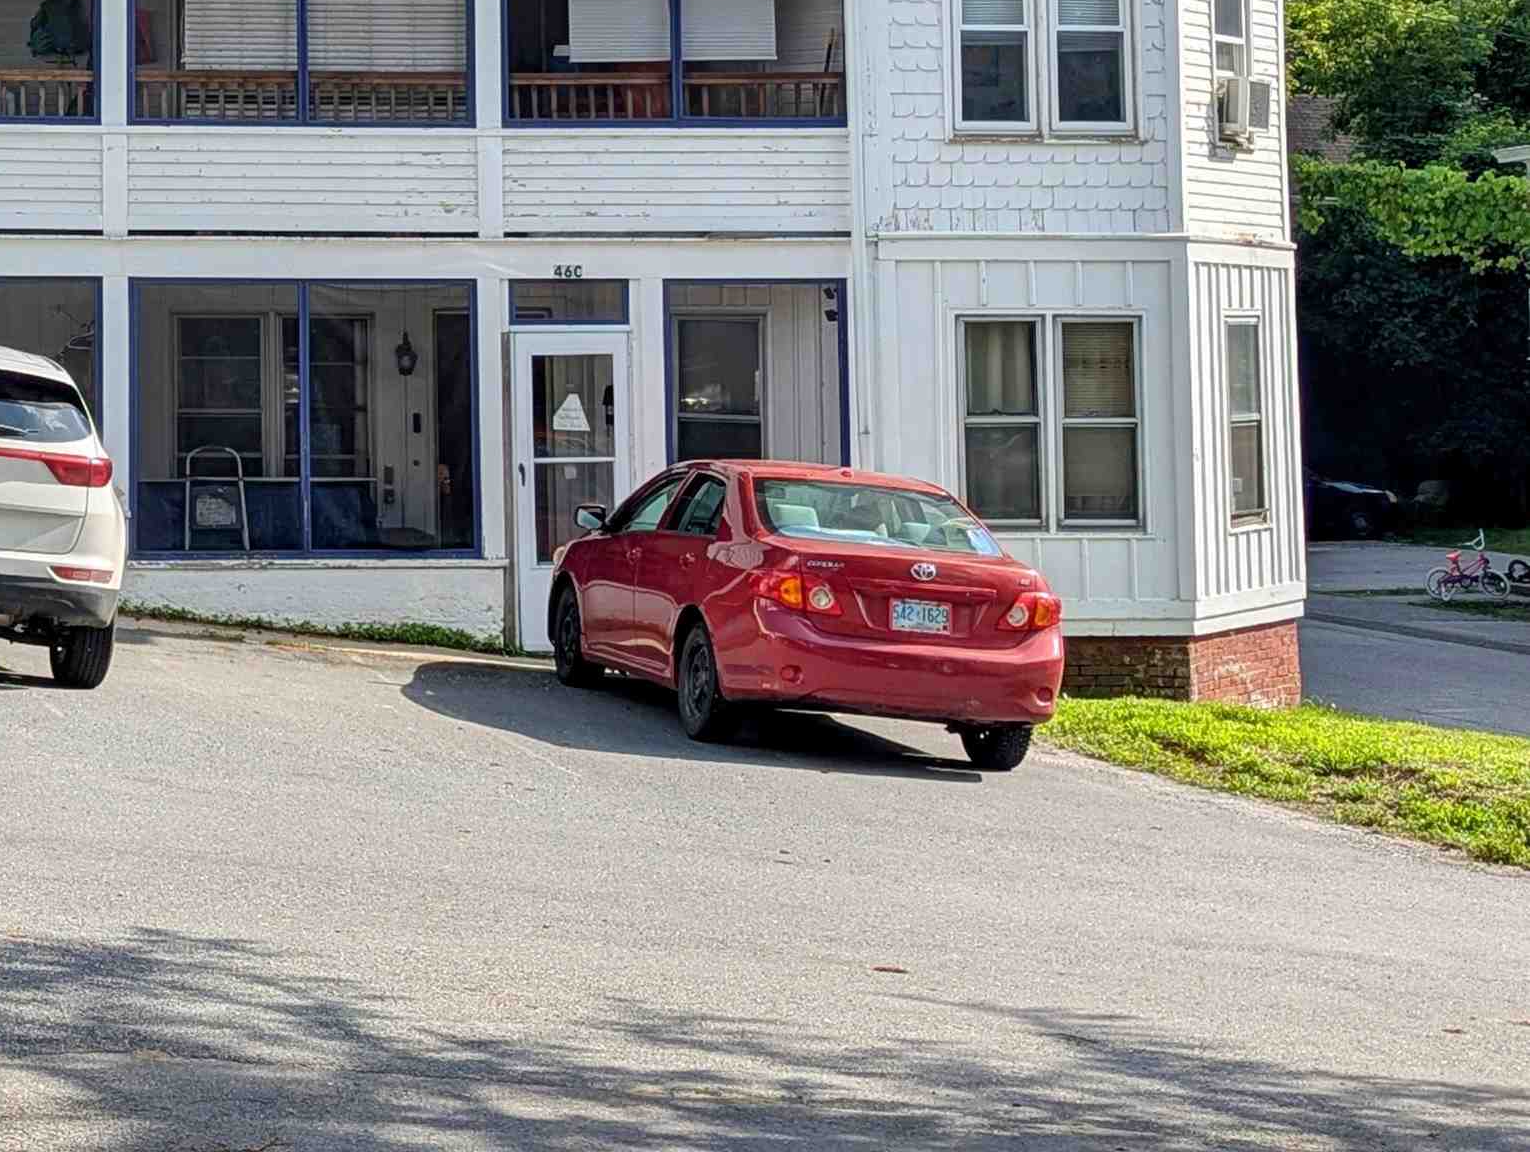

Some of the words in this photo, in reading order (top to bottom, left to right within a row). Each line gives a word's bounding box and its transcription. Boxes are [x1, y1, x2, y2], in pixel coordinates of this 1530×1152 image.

[553, 264, 583, 278] 46C
[893, 604, 915, 622] 542
[922, 607, 949, 624] 1629
